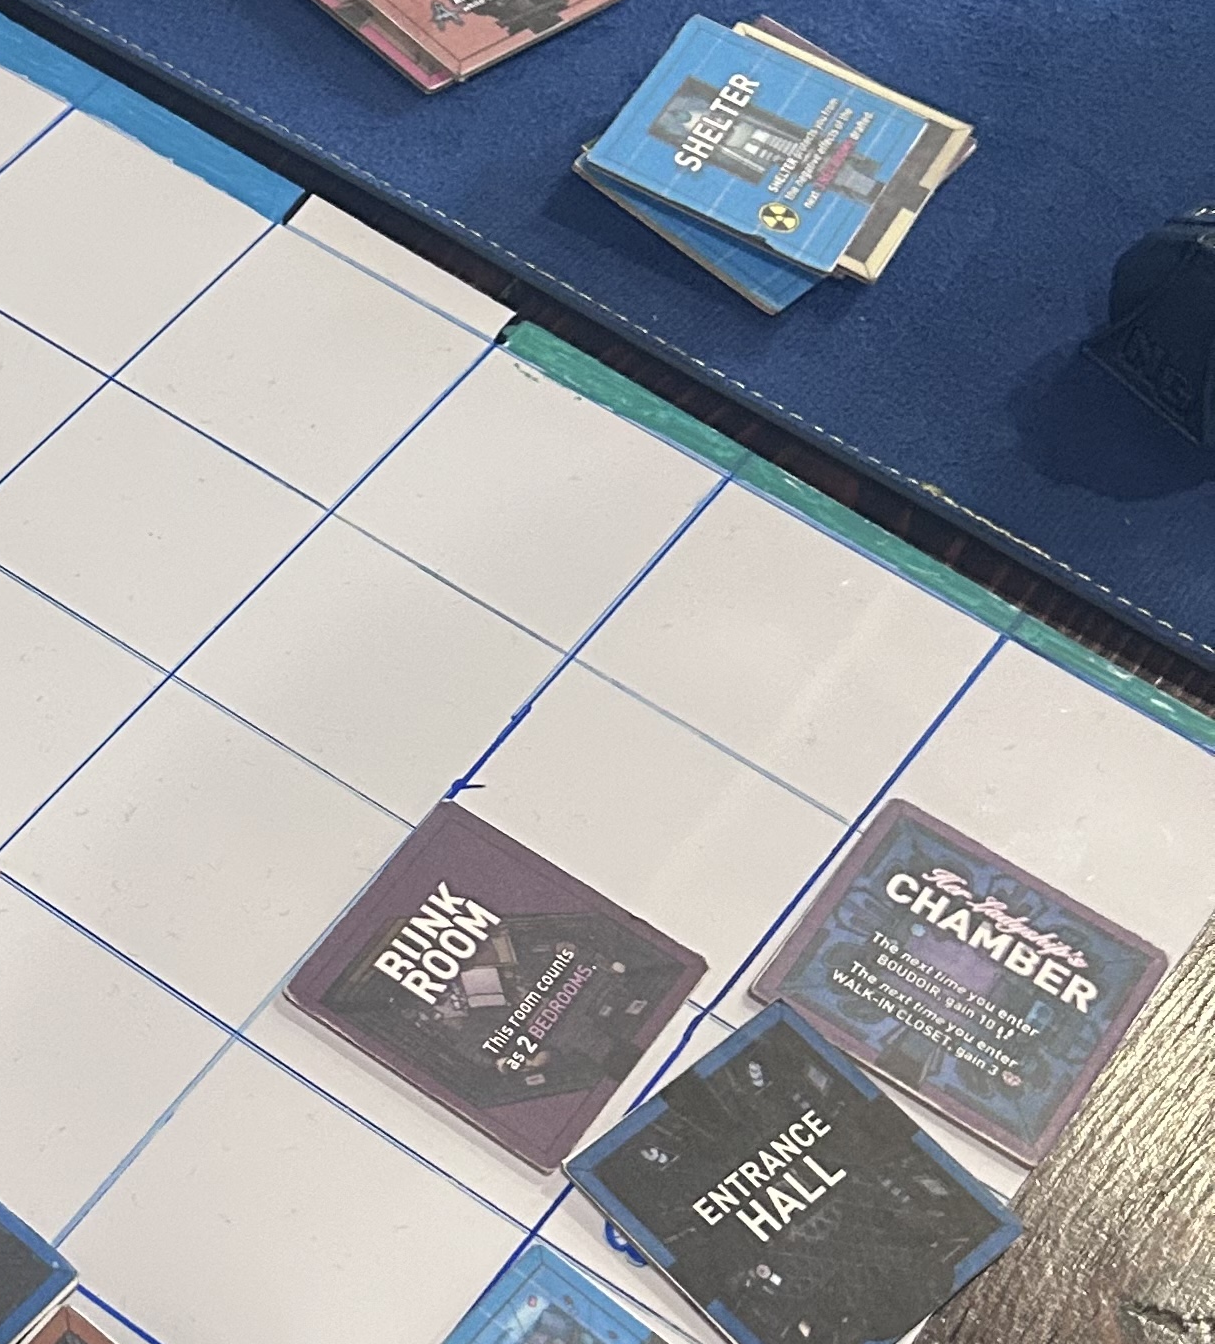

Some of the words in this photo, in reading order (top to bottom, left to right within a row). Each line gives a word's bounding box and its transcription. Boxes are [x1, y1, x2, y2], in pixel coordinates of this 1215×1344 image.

[674, 73, 760, 172] SHELTER
[795, 153, 822, 188] negative
[817, 129, 840, 155] effects
[767, 157, 799, 193] SHELTER
[803, 190, 821, 209] next
[921, 868, 973, 899] Her
[374, 881, 468, 982] BUNK
[399, 899, 501, 1005] ROOM
[885, 872, 1099, 1015] CHAMBER
[482, 1024, 514, 1054] This
[508, 991, 542, 1027] room
[536, 948, 575, 992] counts
[527, 964, 597, 1040] BEDROOMS.
[832, 968, 896, 1014] WALK-IN
[955, 1046, 986, 1070] gain
[987, 1065, 1000, 1077] 3
[850, 961, 878, 984] The
[878, 982, 913, 1006] next
[913, 1001, 945, 1026] time
[945, 1021, 975, 1044] you
[976, 1040, 1019, 1068] enter
[872, 931, 899, 954] The
[900, 951, 935, 975] next
[934, 970, 968, 995] time
[966, 991, 996, 1013] you
[997, 1010, 1041, 1037] enter
[945, 995, 975, 1019] gain
[978, 1014, 996, 1030] 10
[506, 1051, 525, 1070] as
[516, 1035, 539, 1054] 2
[692, 1110, 832, 1226] ENTRANCE
[736, 1155, 847, 1243] HALL
